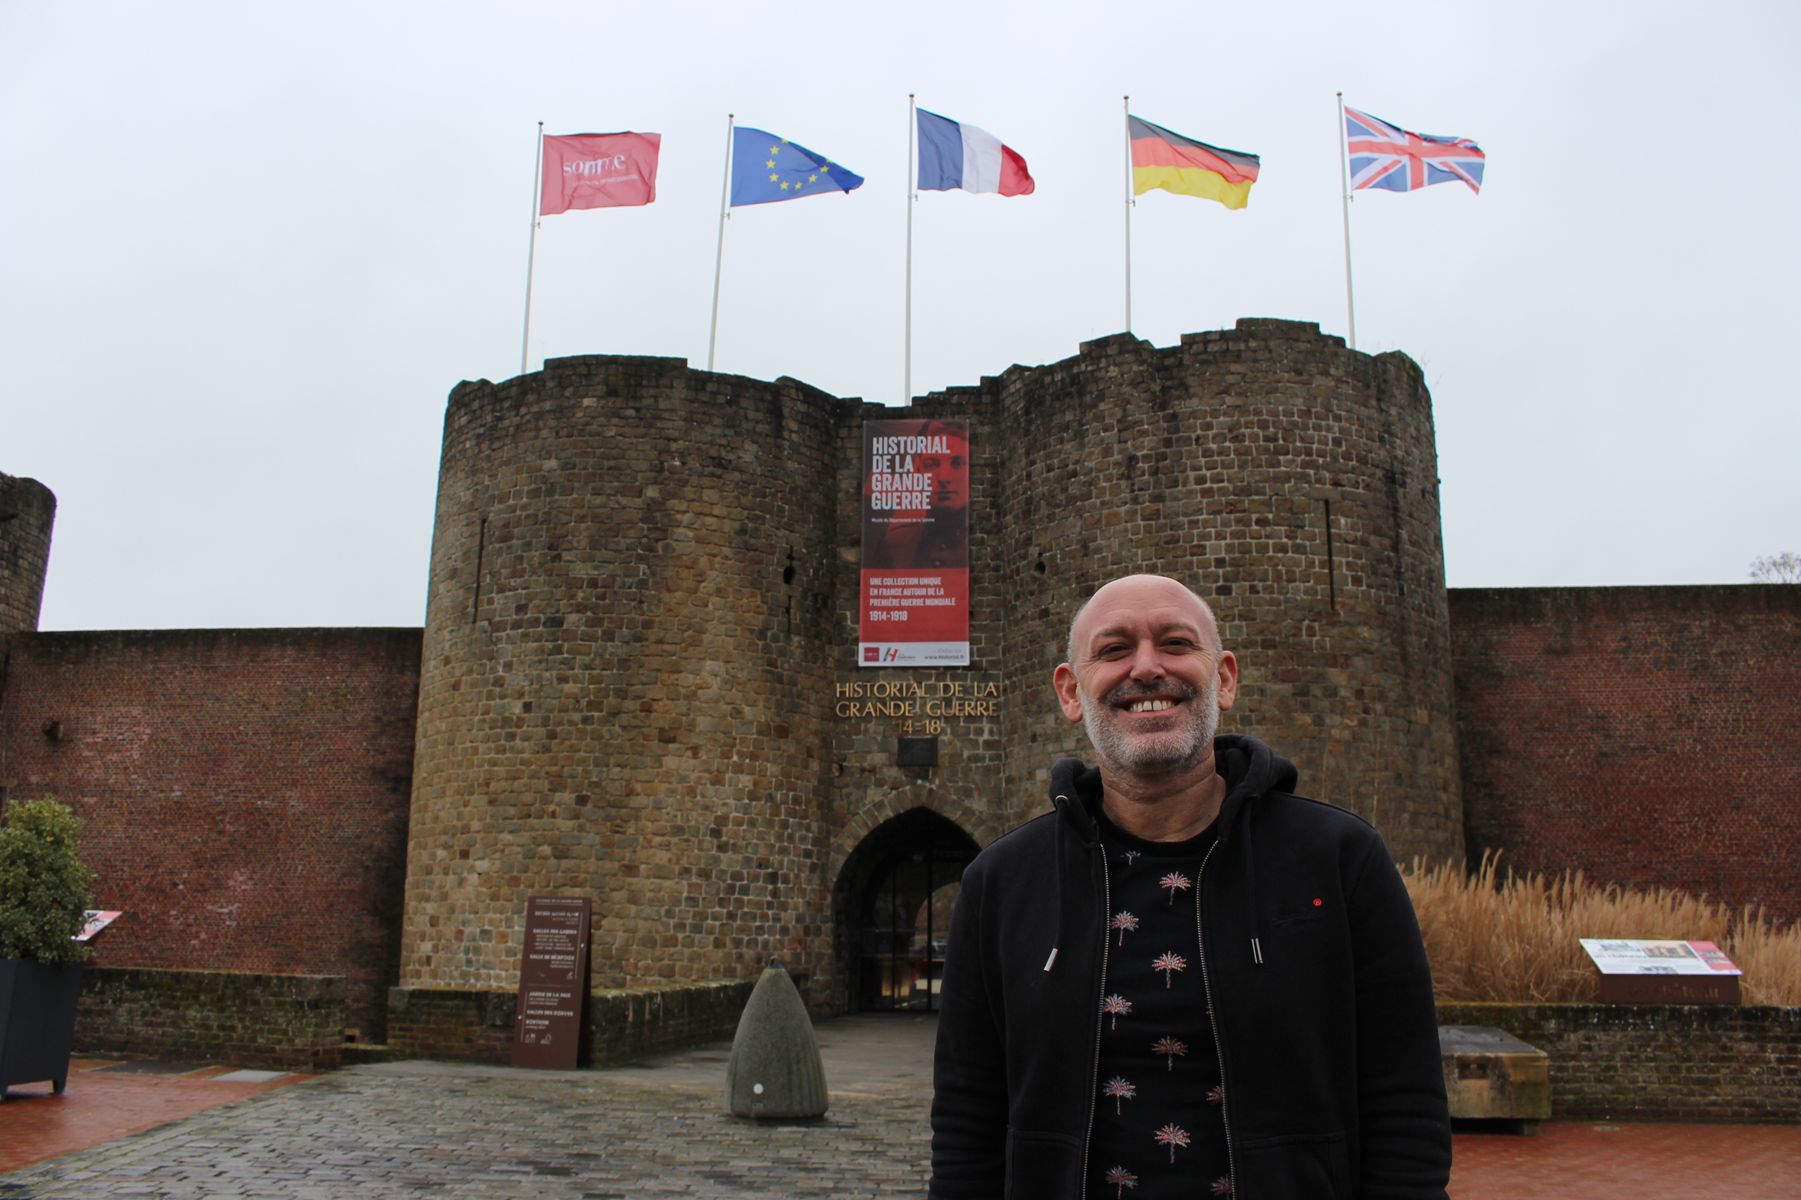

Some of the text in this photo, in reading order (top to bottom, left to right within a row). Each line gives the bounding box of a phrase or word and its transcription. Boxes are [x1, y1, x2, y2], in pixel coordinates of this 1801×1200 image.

[872, 436, 951, 454] HISTORIAL
[872, 454, 914, 473] DE LA
[872, 473, 933, 491] GRANDE
[871, 492, 931, 510] GUERRE
[870, 577, 941, 586] UNE COLLECTION UNIQUE
[879, 588, 902, 596] FRANCE
[903, 588, 927, 596] AUTOUR
[927, 588, 936, 596] DE
[870, 597, 956, 606] PREMIÈRE GUERRE MONDIALE
[869, 610, 908, 621] 1914-1918
[836, 681, 998, 698] HISTORIAL DE LA
[835, 700, 998, 718] GRANDE GUERRE
